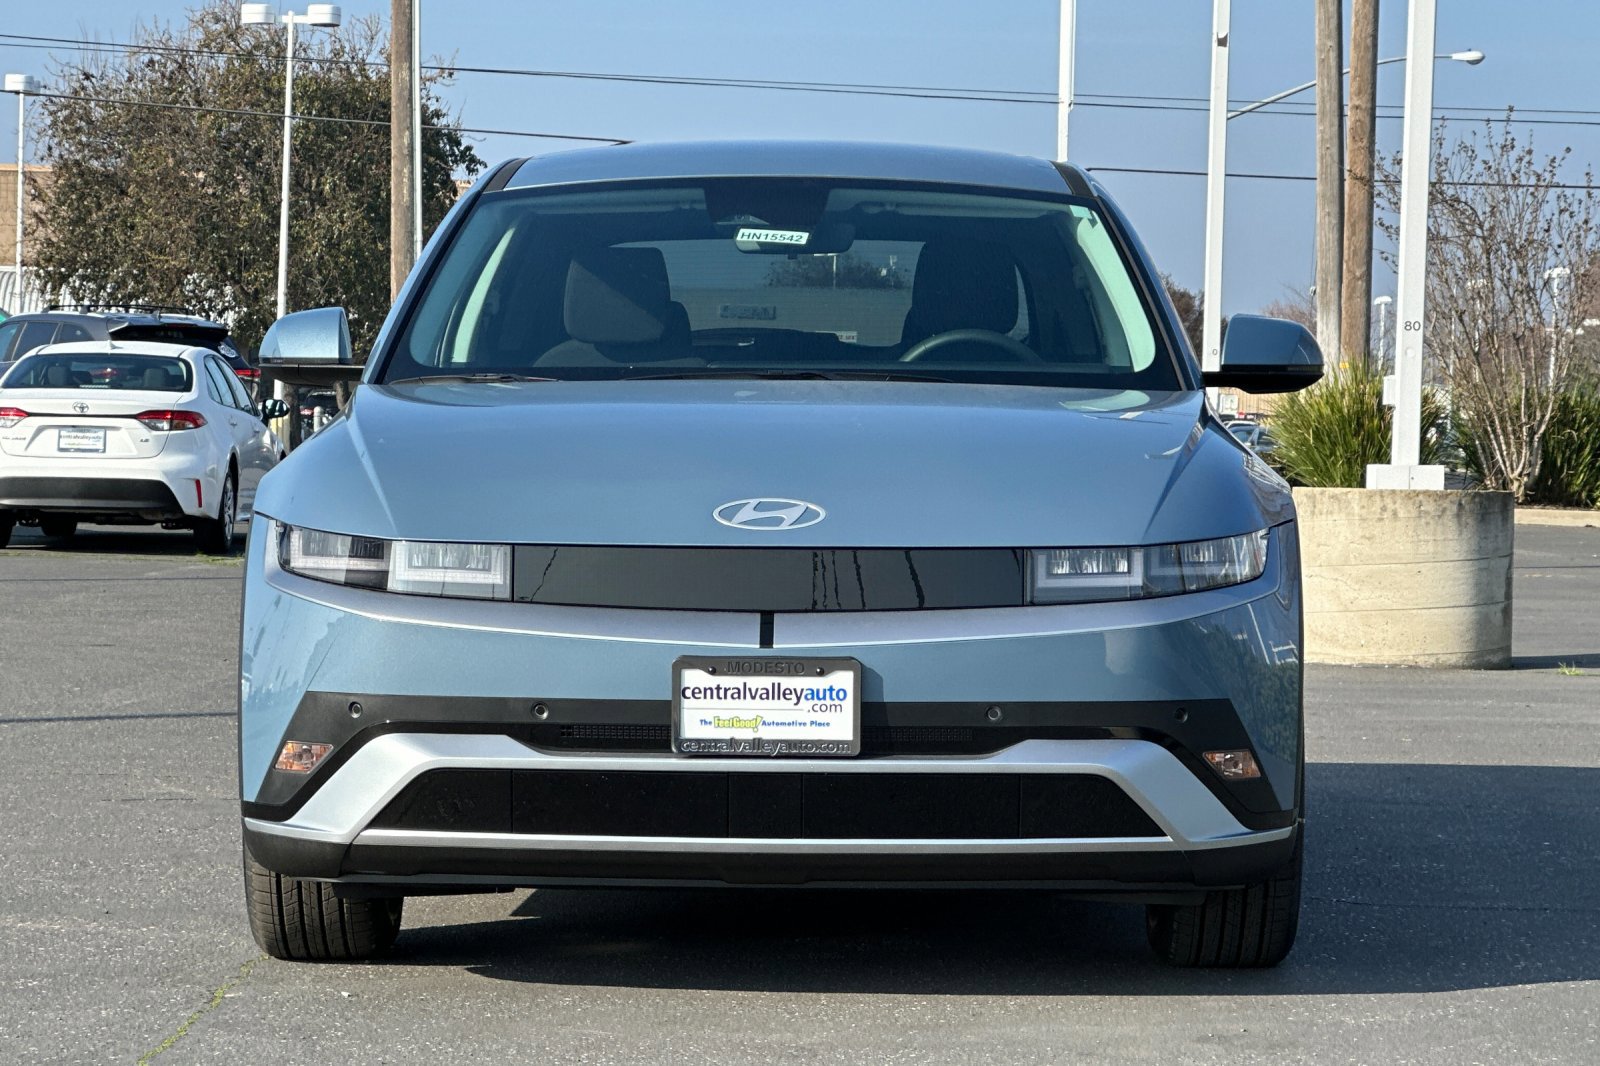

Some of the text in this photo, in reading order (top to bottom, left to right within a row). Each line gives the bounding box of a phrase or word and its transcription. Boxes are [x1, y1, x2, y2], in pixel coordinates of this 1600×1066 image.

[740, 231, 803, 243] HN15542
[1404, 320, 1421, 331] 80
[727, 661, 805, 675] MODESTO
[681, 682, 847, 706] centralvalleyauto
[807, 703, 843, 713] .com
[681, 737, 851, 757] centralvalleyauto.com
